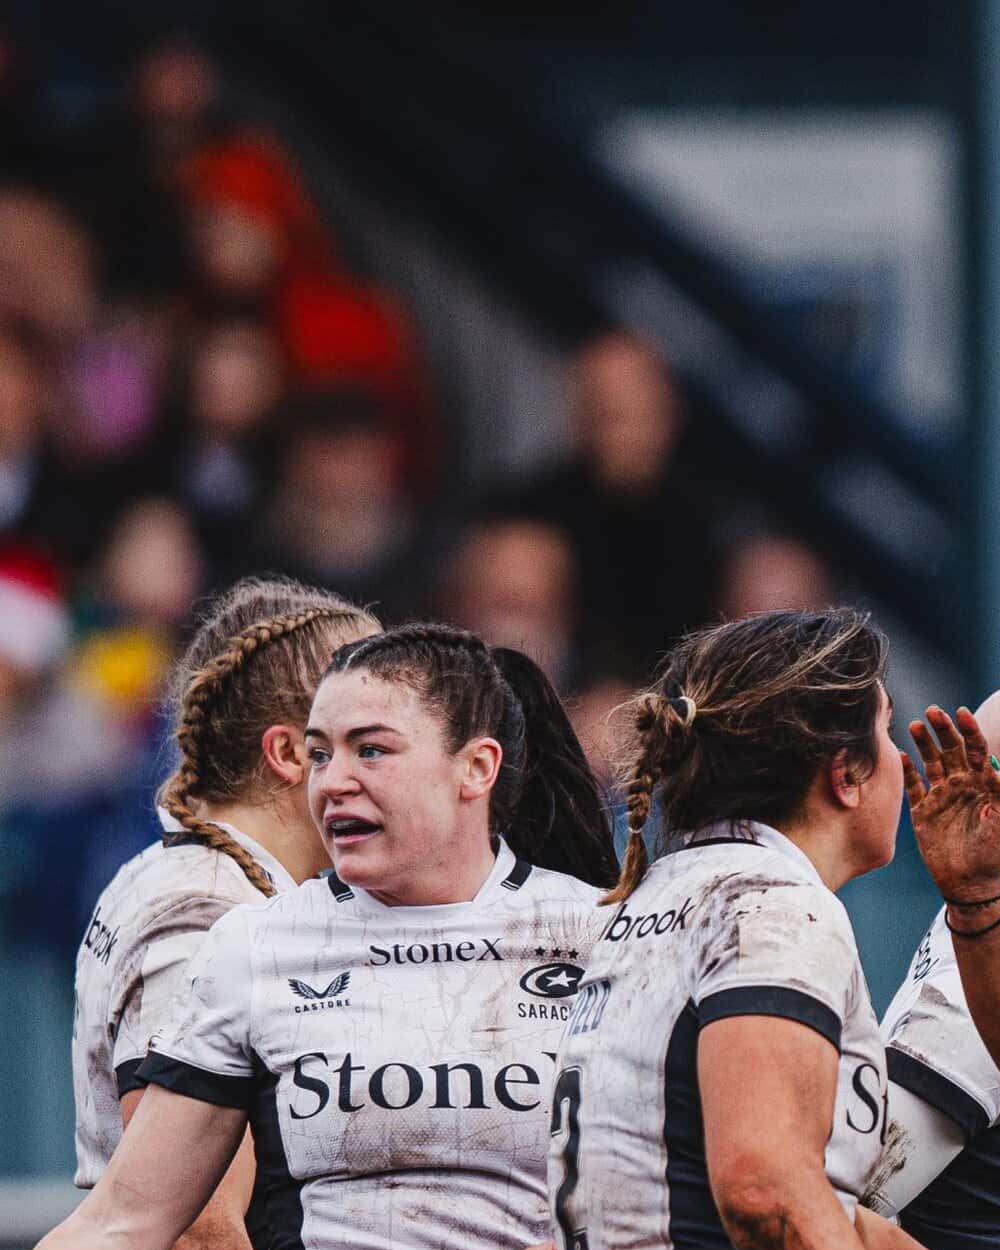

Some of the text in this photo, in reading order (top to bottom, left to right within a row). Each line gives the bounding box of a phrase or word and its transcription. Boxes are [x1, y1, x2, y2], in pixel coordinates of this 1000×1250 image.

[601, 897, 697, 941] brook
[294, 998, 352, 1014] CASTORE
[517, 1002, 573, 1022] SARAC
[289, 1051, 558, 1120] Stone
